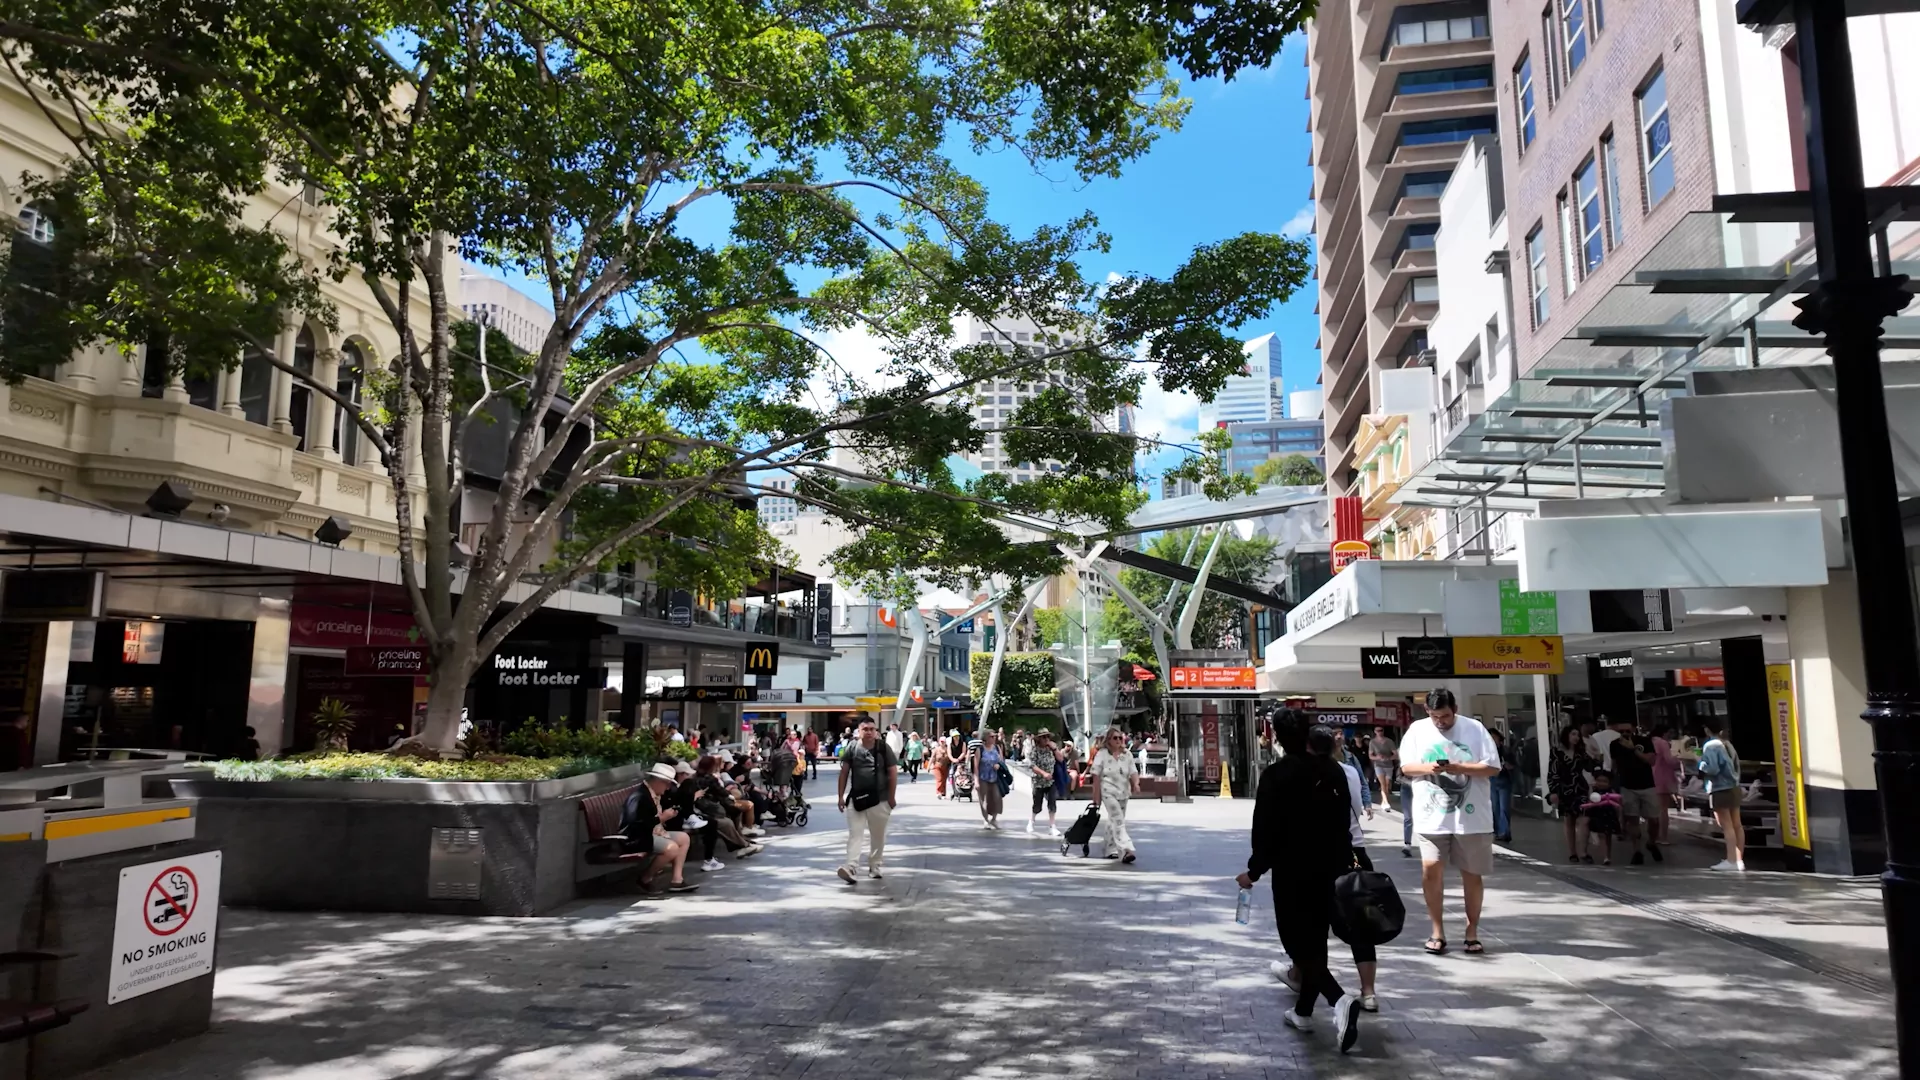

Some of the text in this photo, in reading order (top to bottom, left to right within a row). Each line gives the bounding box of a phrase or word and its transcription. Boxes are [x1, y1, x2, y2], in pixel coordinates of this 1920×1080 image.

[1501, 591, 1555, 599] ENGLISH
[316, 621, 363, 634] priceline
[378, 649, 422, 661] priceline
[378, 660, 422, 671] pharmacy
[495, 654, 548, 669] Foot Locker
[1468, 660, 1551, 671] Hakataya Ramen
[1600, 658, 1619, 667] WALLACE
[499, 672, 580, 685] Foot Locker
[1190, 673, 1197, 682] 2
[769, 691, 783, 700] hill
[1317, 714, 1358, 724] OPTUS
[1206, 722, 1215, 735] 2
[1778, 701, 1799, 838] Hakataya Ramen
[122, 932, 206, 965] NO SMOKING
[129, 952, 198, 977] UNDER QUEENSLAND
[117, 960, 206, 992] GOVERNMENT LEGISLATION
